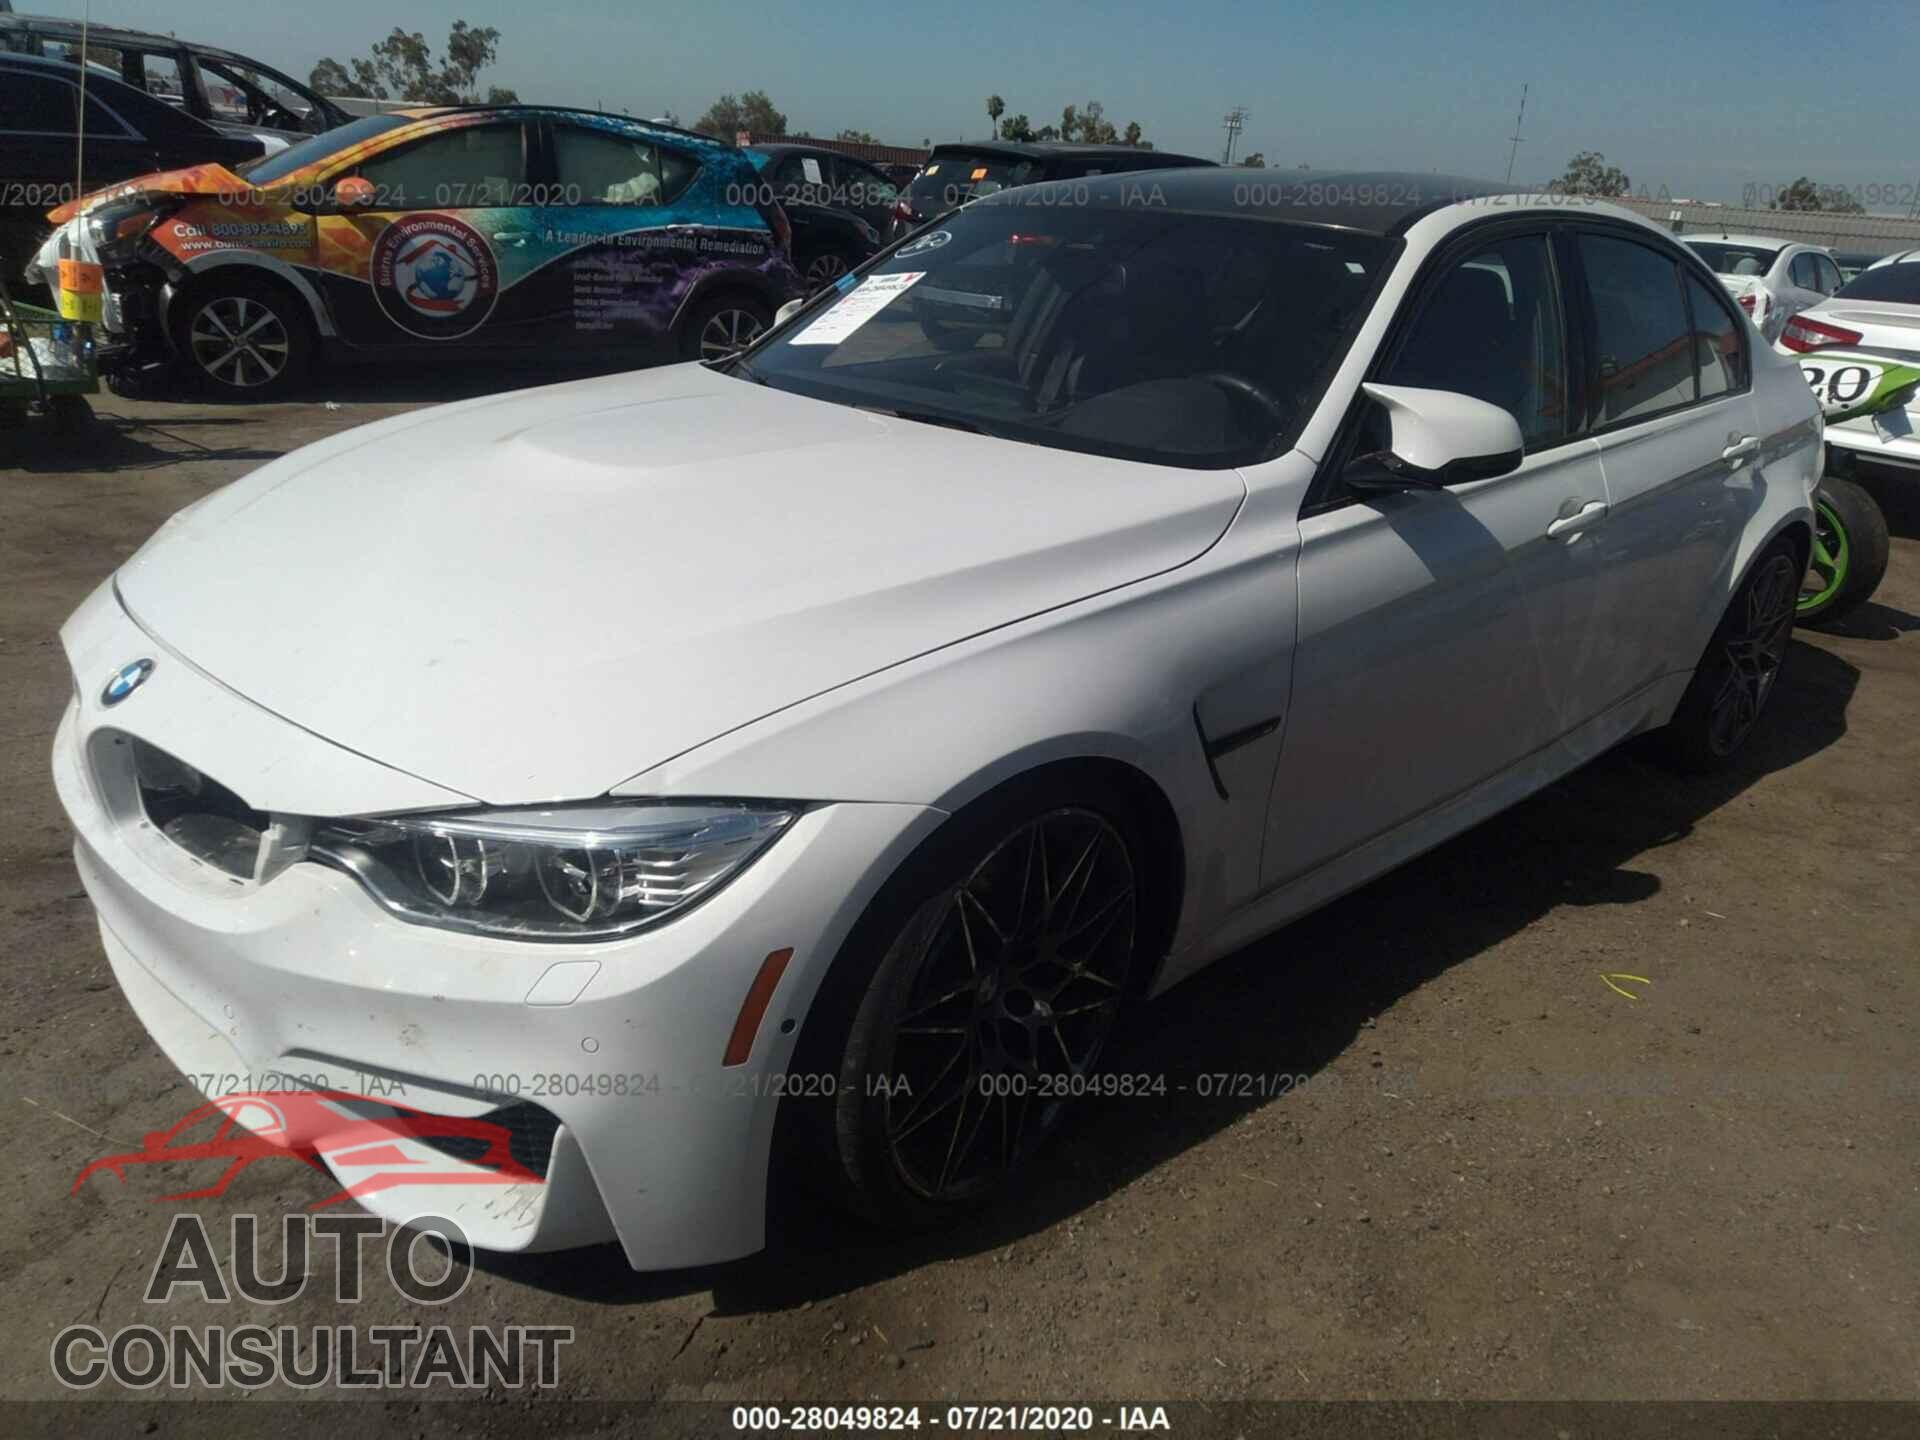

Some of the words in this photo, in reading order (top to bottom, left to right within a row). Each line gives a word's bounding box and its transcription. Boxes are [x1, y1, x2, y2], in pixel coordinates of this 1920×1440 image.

[387, 220, 468, 249] Environmental
[617, 235, 698, 249] Environmental
[701, 239, 764, 255] Remediation
